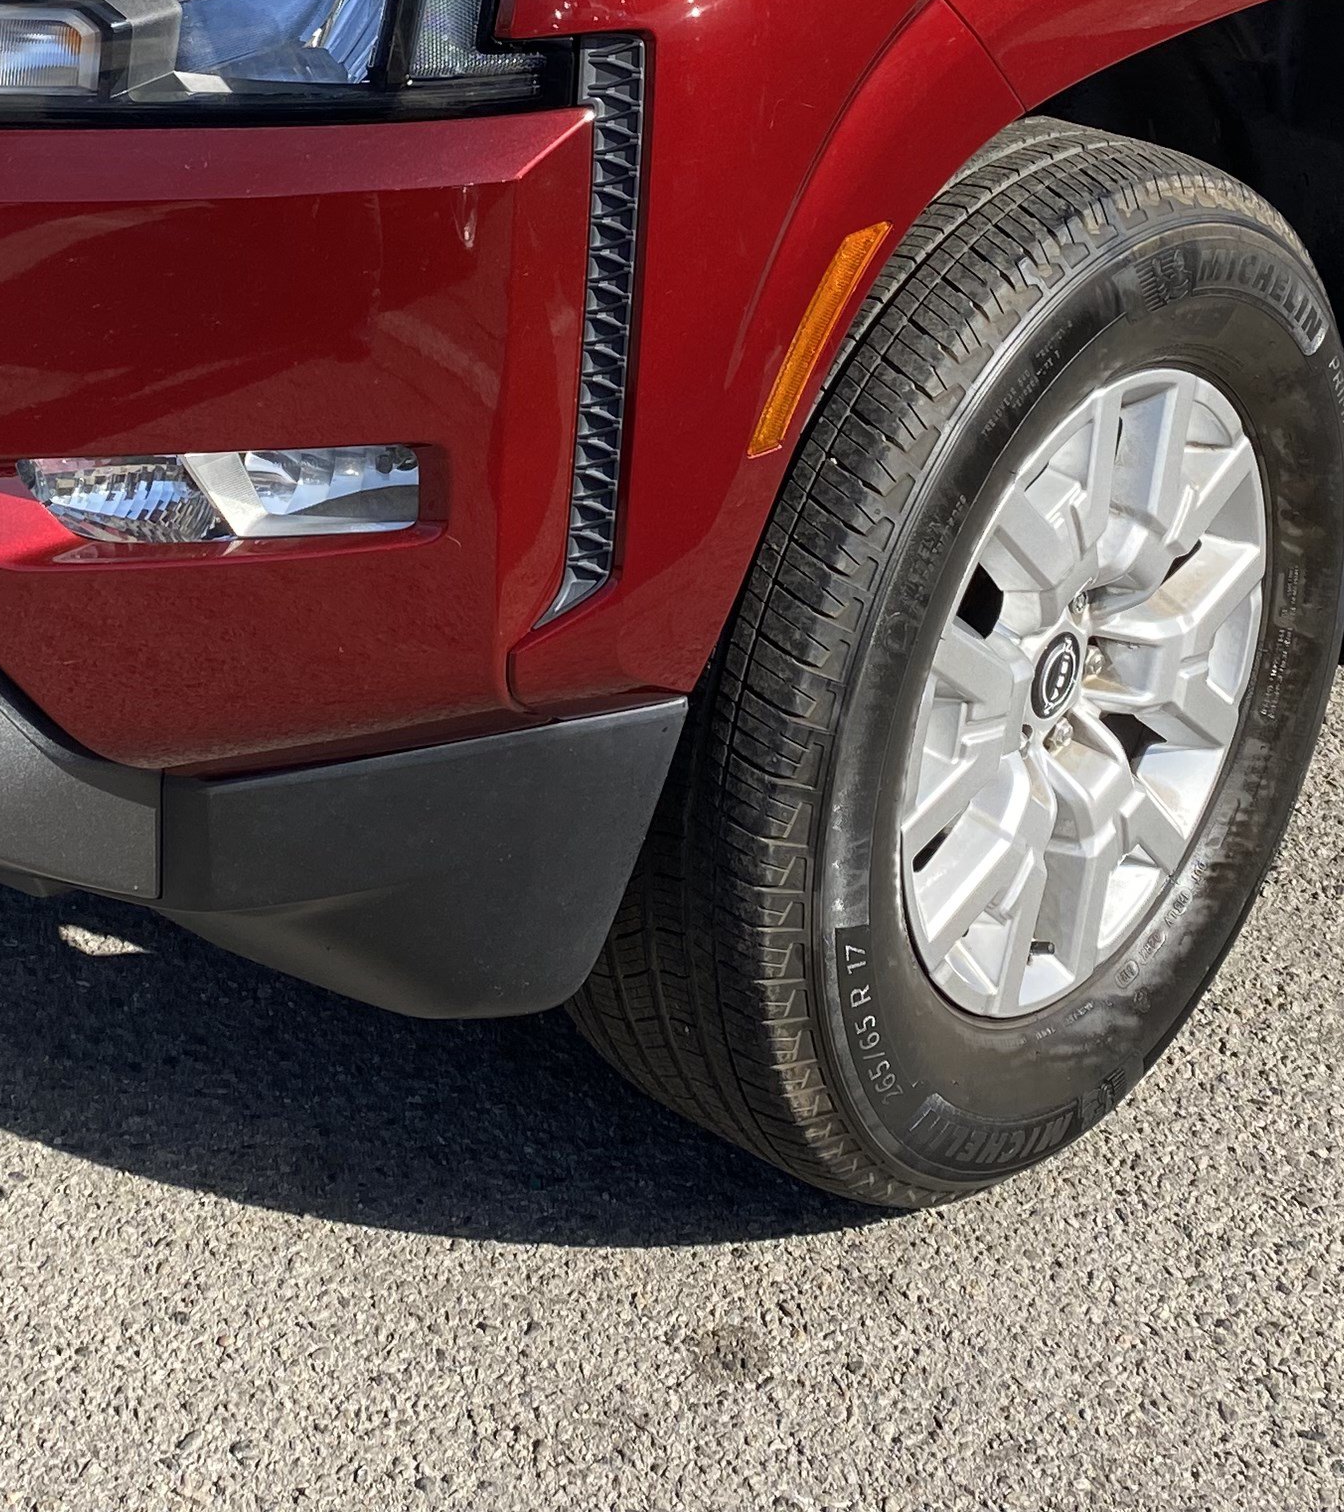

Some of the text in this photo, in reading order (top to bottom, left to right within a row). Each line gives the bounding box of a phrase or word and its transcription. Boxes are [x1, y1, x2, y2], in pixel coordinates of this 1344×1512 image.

[1196, 248, 1324, 343] MICHELIN
[844, 944, 905, 1106] 265/65 R 17
